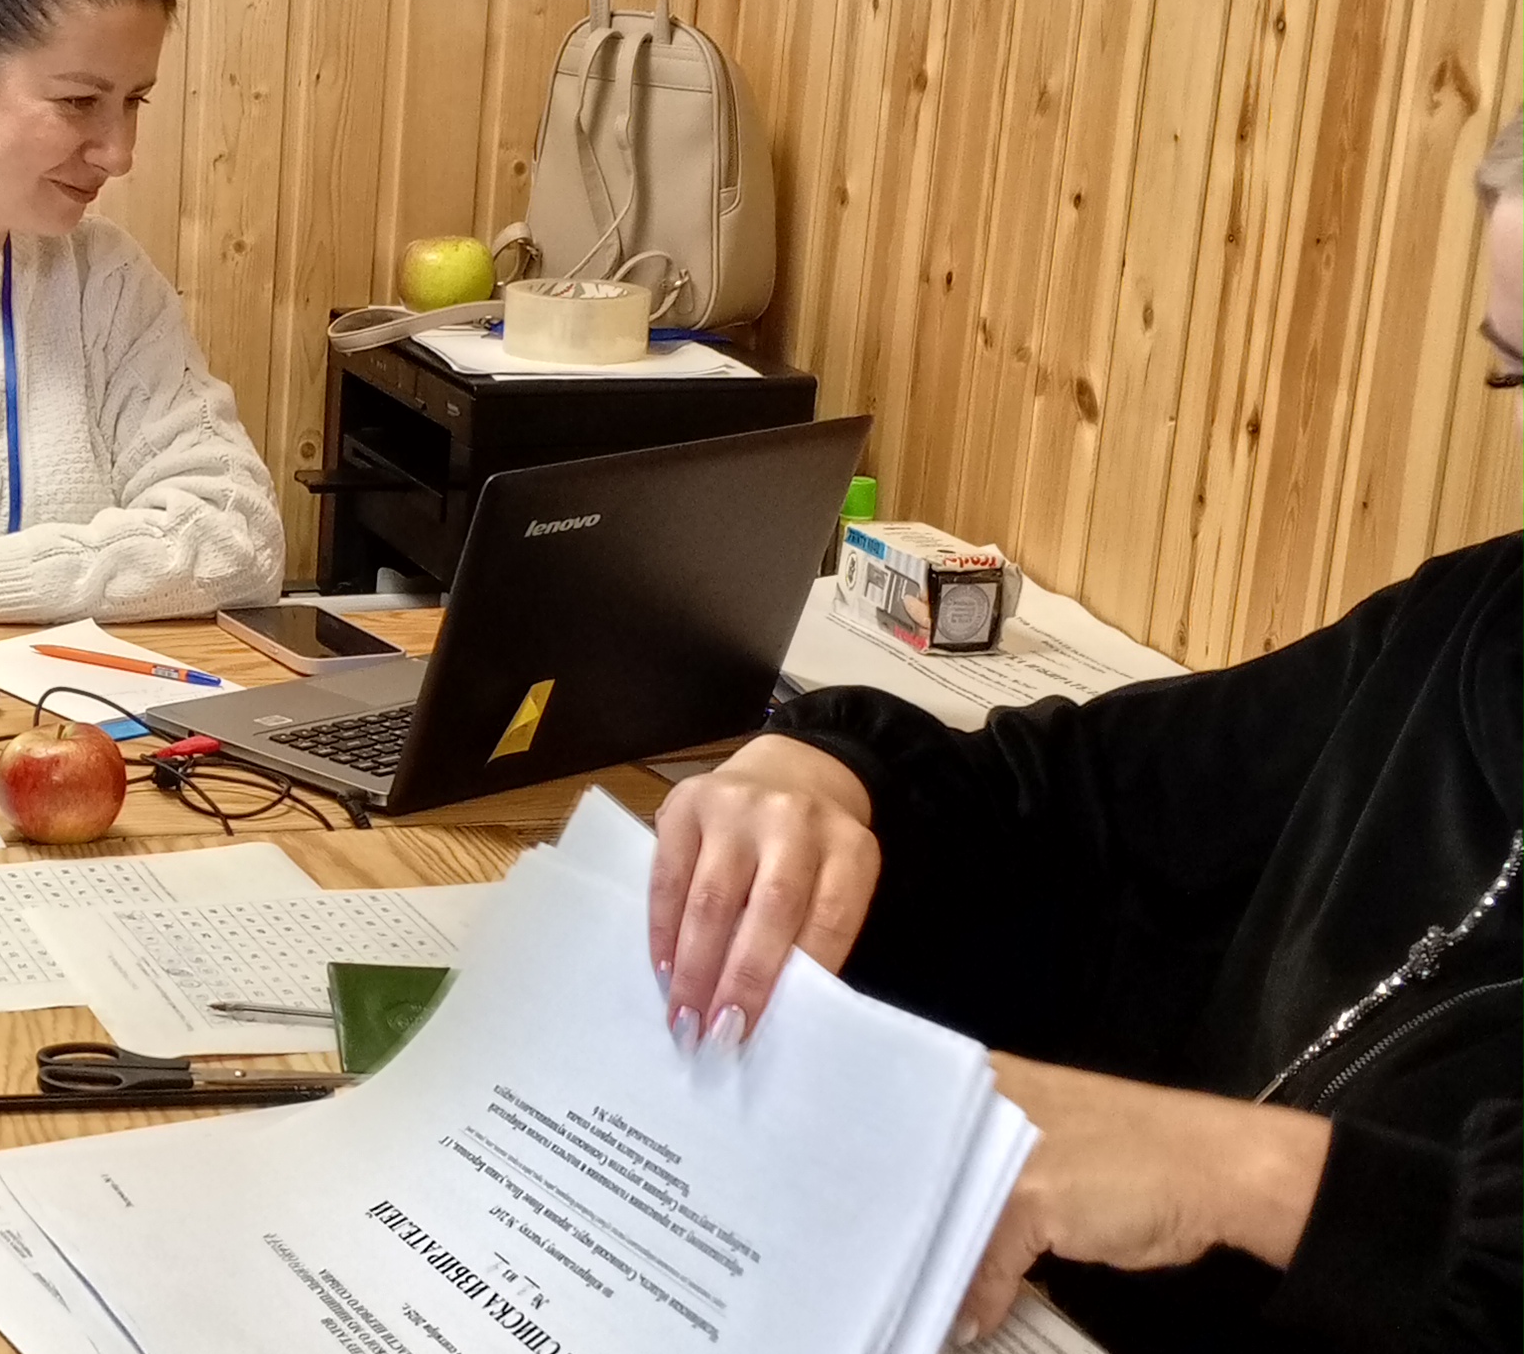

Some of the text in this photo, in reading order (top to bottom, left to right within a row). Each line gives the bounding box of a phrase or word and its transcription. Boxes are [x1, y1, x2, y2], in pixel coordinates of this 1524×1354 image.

[524, 514, 601, 537] lenovo
[364, 1196, 490, 1301] ИЗБИРАТЕЛЕЙ
[501, 1268, 550, 1311] № из
